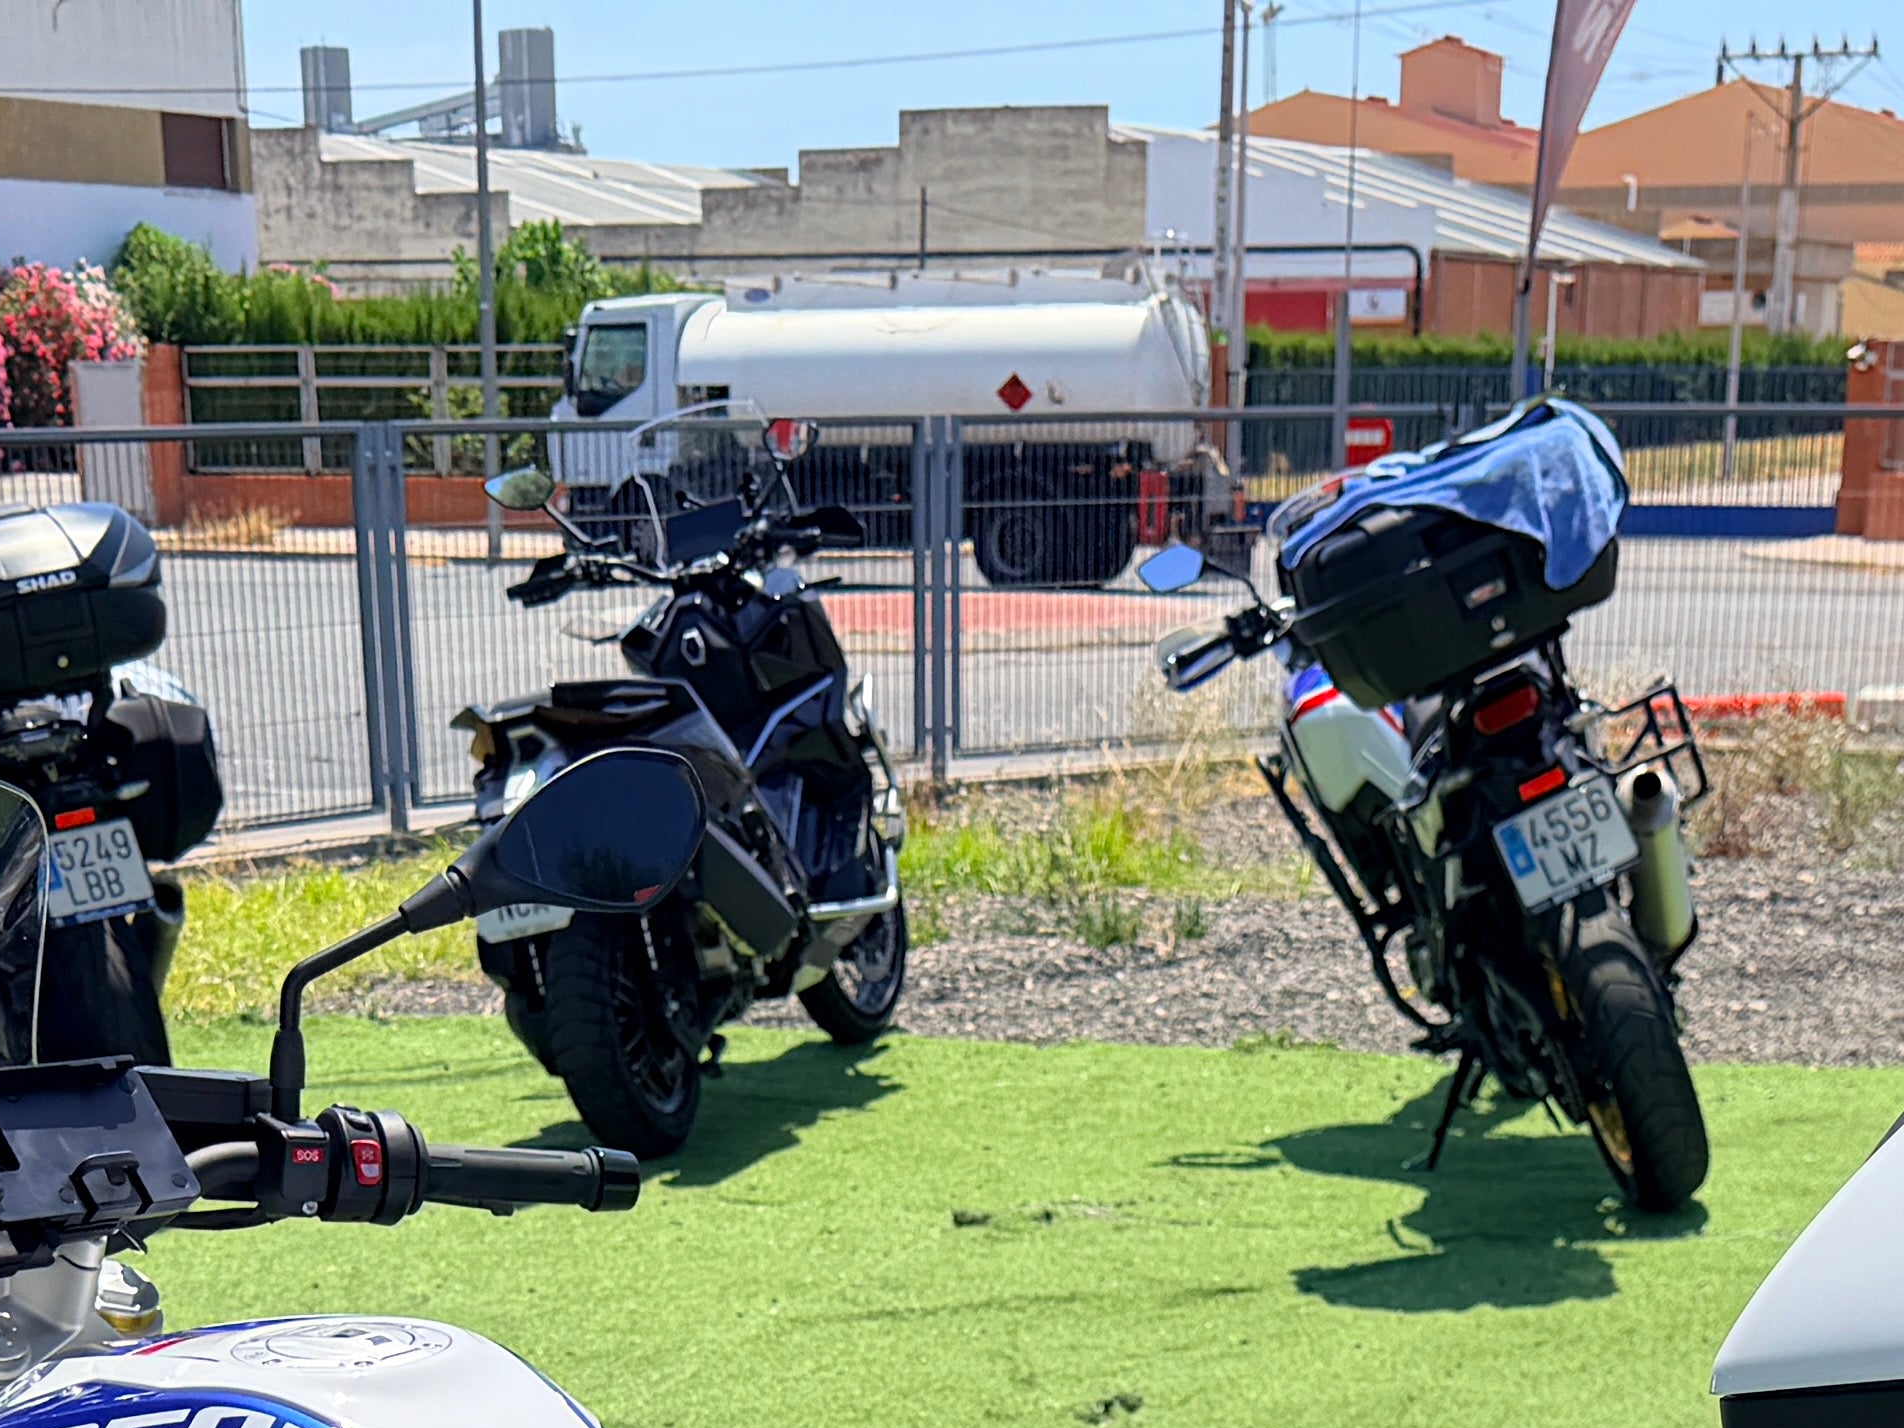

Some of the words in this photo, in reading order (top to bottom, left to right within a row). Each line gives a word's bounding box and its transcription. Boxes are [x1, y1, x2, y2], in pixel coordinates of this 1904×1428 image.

[16, 570, 77, 595] SHAD
[1529, 787, 1612, 849] 4556
[53, 829, 132, 871] 5249
[1538, 832, 1609, 888] LMZ
[65, 867, 126, 907] LBB
[296, 1149, 319, 1162] SOS
